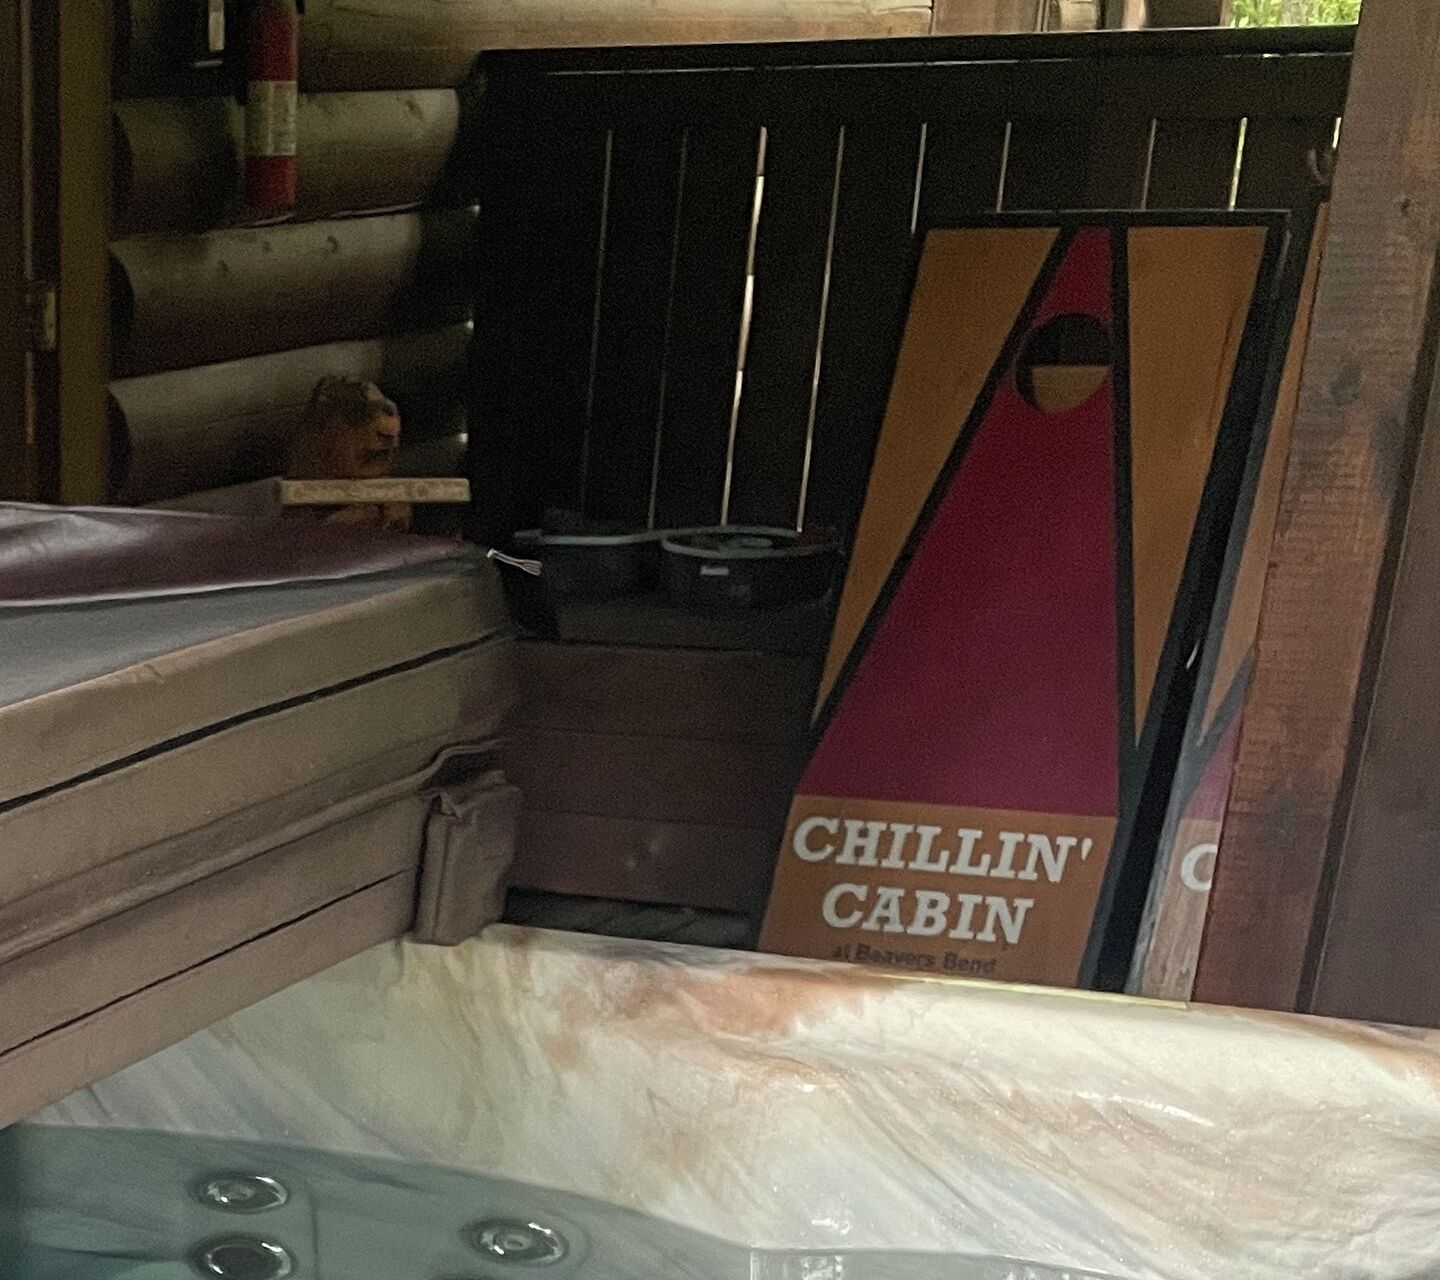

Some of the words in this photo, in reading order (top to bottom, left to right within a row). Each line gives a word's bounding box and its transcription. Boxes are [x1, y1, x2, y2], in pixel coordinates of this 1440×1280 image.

[793, 816, 1093, 882] CHILLIN'
[822, 882, 1034, 945] CABIN
[942, 952, 997, 974] Bend
